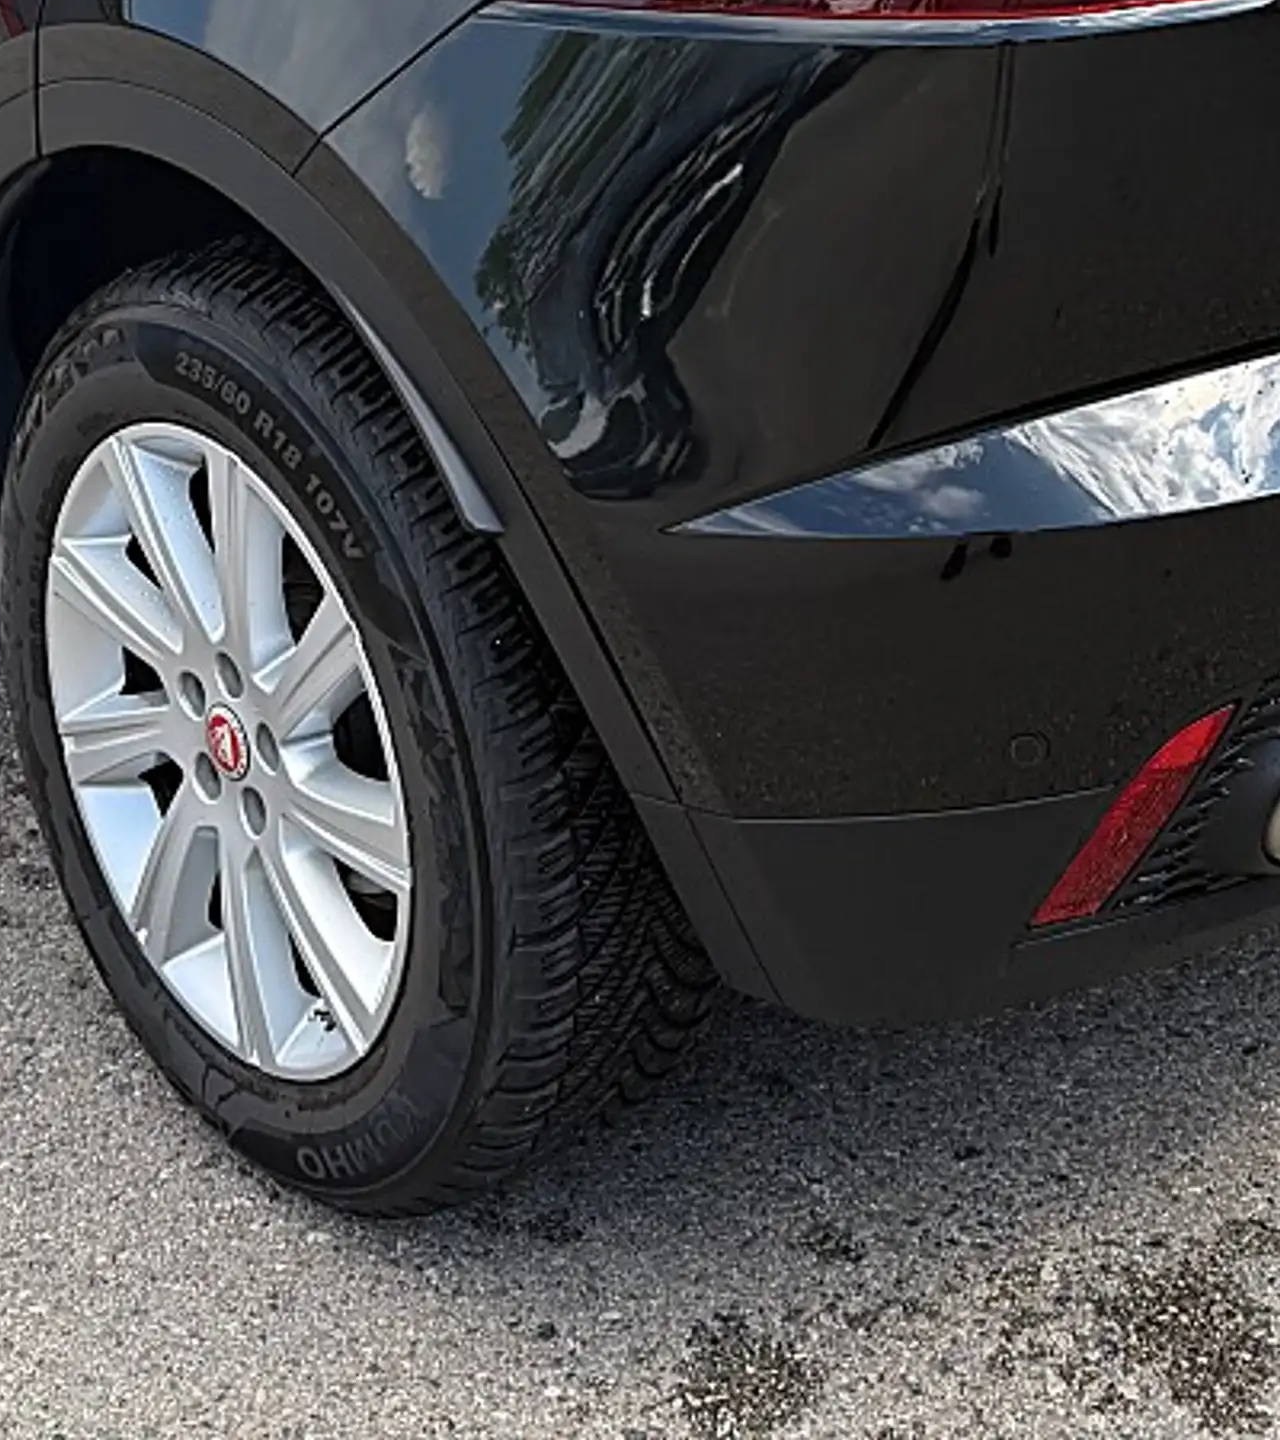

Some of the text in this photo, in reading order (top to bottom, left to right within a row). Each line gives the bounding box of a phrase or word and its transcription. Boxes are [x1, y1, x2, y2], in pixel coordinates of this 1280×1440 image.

[175, 351, 366, 559] 235/60 R18 107V
